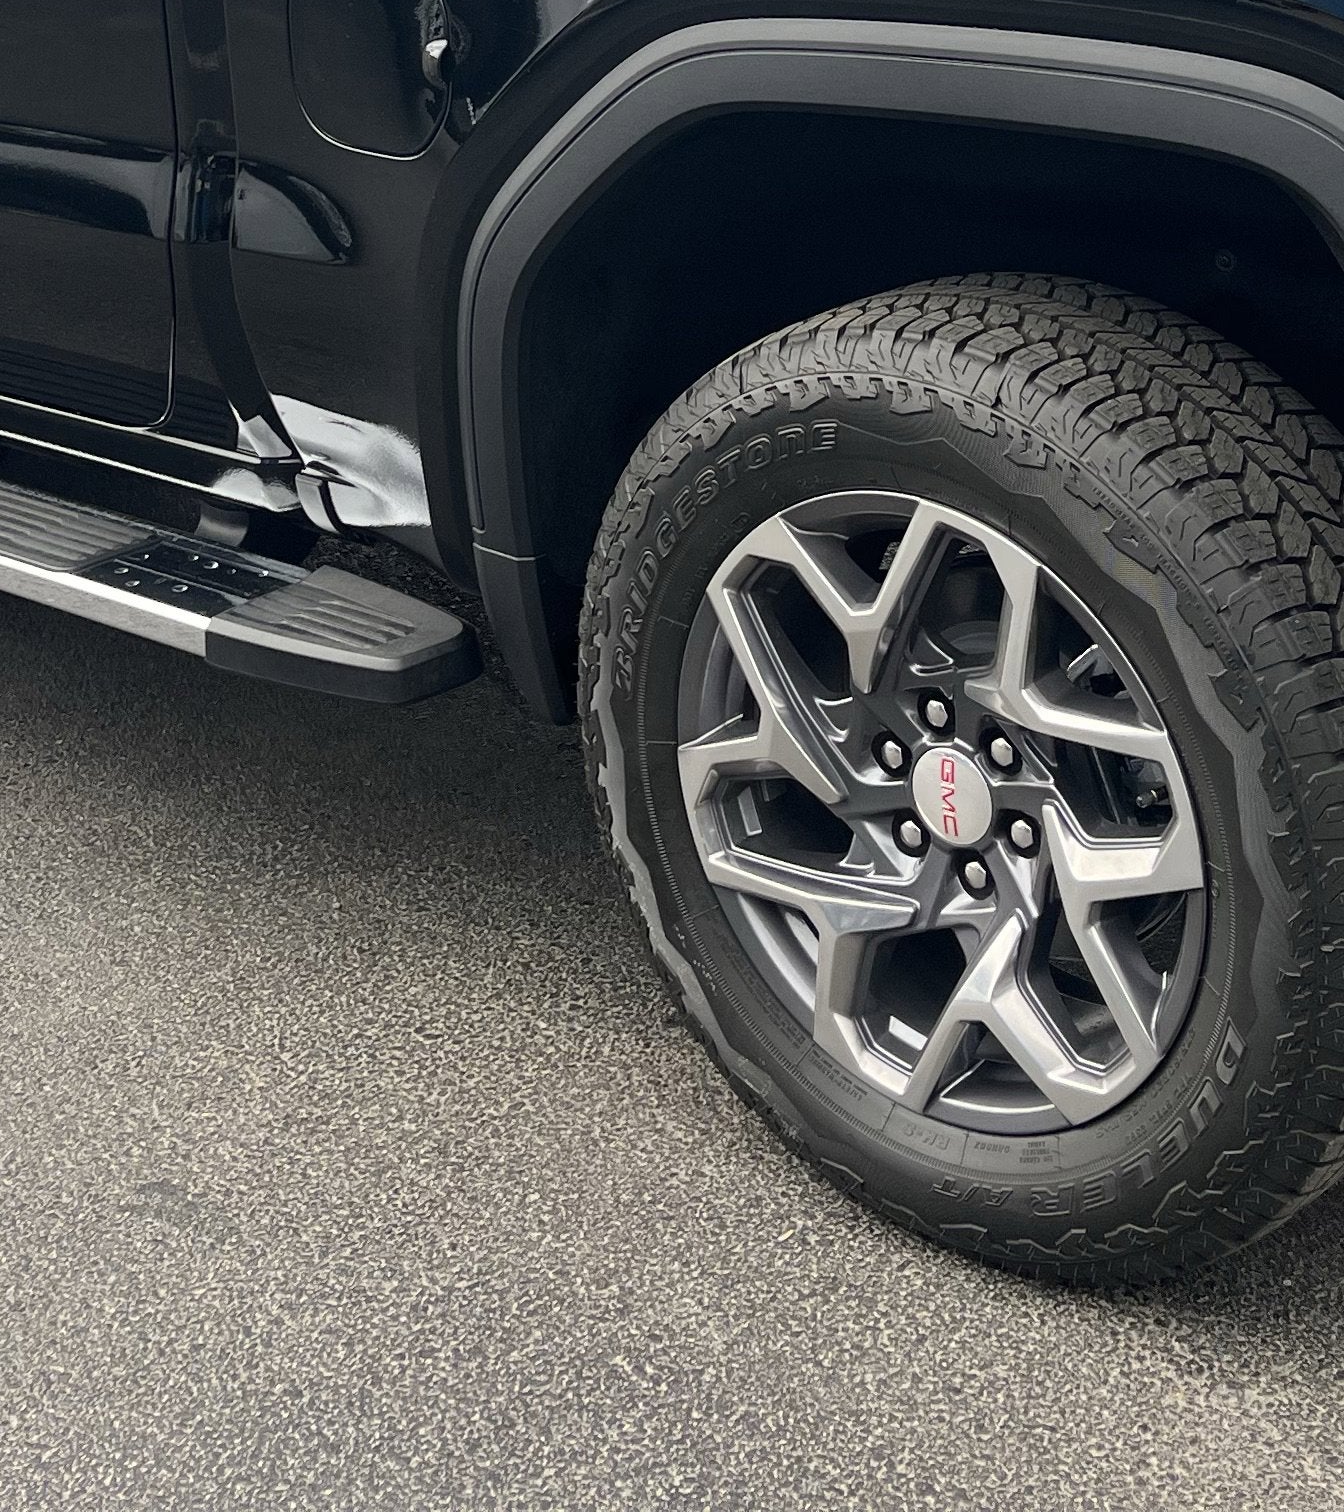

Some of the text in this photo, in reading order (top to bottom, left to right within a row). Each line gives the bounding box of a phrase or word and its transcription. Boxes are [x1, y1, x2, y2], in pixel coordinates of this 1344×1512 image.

[610, 418, 840, 699] BRIDGESTONE
[939, 755, 959, 837] GMC
[1030, 1016, 1247, 1217] DUELER
[931, 1176, 1014, 1208] A/T
